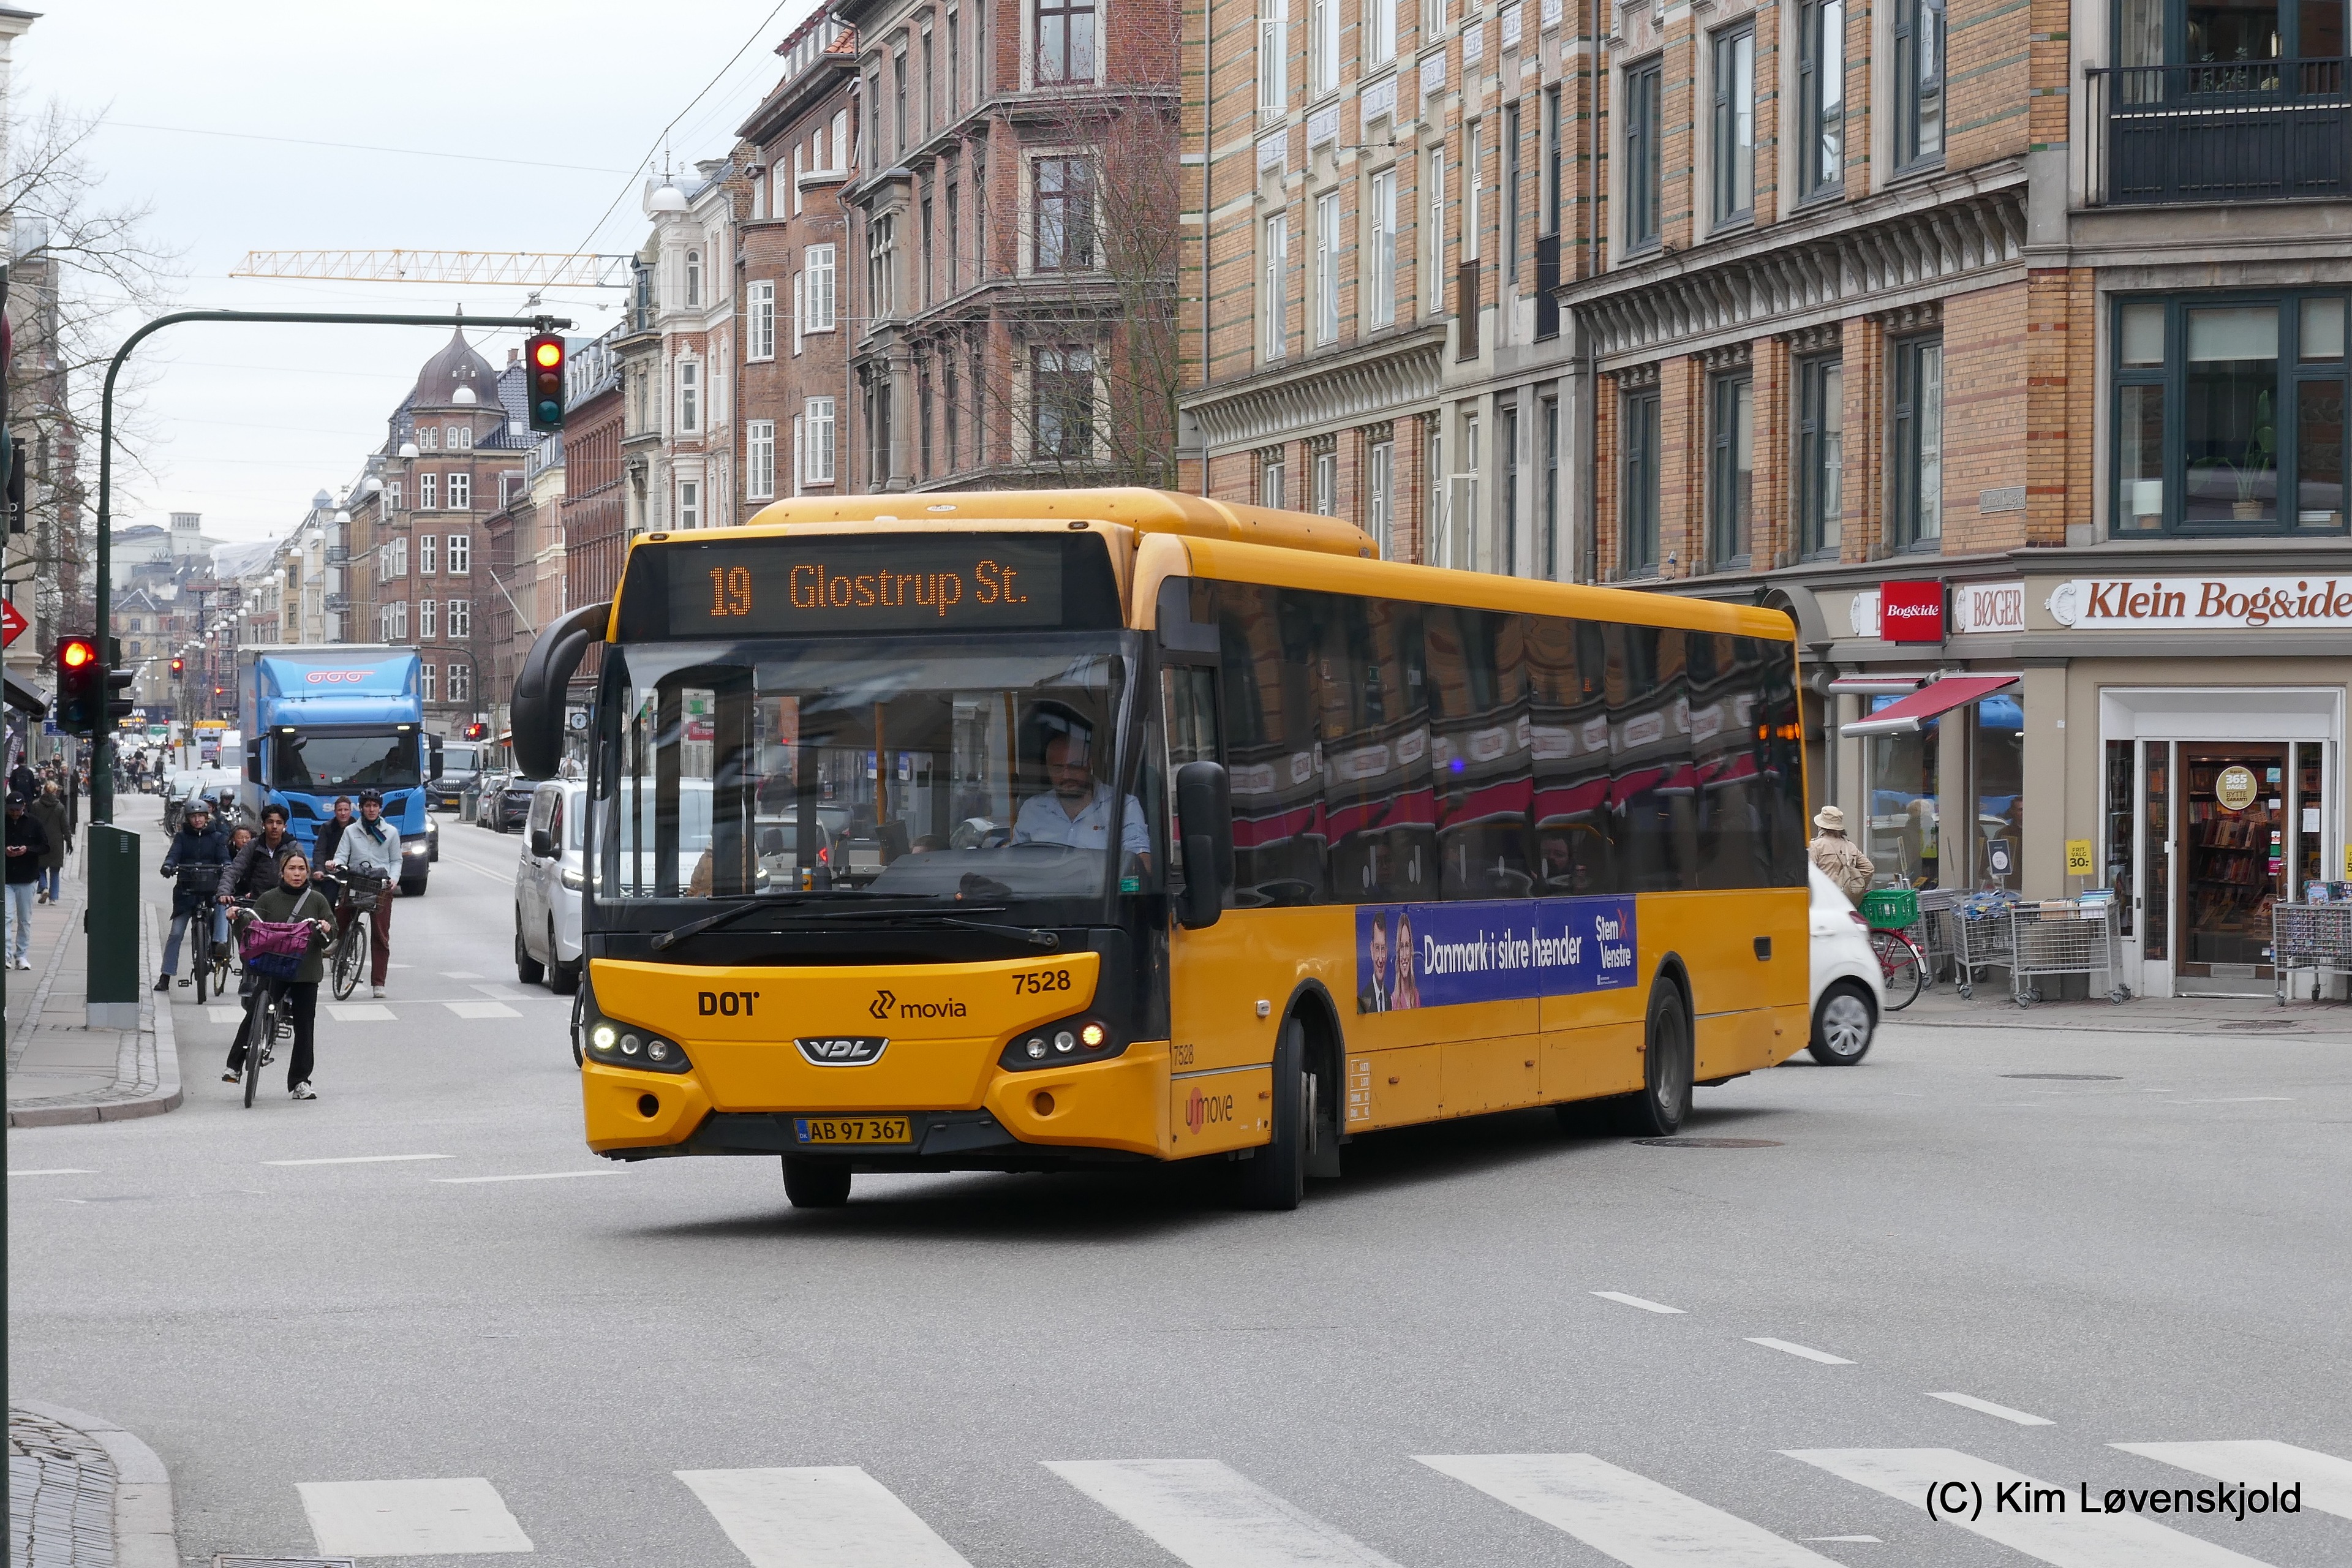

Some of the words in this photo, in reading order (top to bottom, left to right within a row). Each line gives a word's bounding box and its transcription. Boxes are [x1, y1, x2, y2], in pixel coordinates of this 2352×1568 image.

[710, 566, 750, 616] 19
[790, 564, 962, 617] Glostrup
[975, 560, 1027, 603] St.
[2085, 581, 2186, 618] Klein
[1887, 604, 1939, 619] Bog&idé
[1973, 589, 2022, 627] BØGER
[2225, 774, 2248, 784] 365
[1596, 914, 1619, 942] Stem
[1423, 929, 1488, 975] Danmark
[1490, 932, 1495, 970] i
[1498, 928, 1529, 970] sikre
[1531, 925, 1582, 967] hænder
[1600, 940, 1631, 970] Venstre
[1011, 970, 1071, 995] 7528
[698, 991, 760, 1017] DOT
[900, 997, 967, 1019] movia
[809, 1041, 871, 1057] VDL
[1173, 1044, 1194, 1066] 7528
[811, 1121, 837, 1140] AB
[841, 1121, 862, 1140] 97
[870, 1120, 906, 1140] 367
